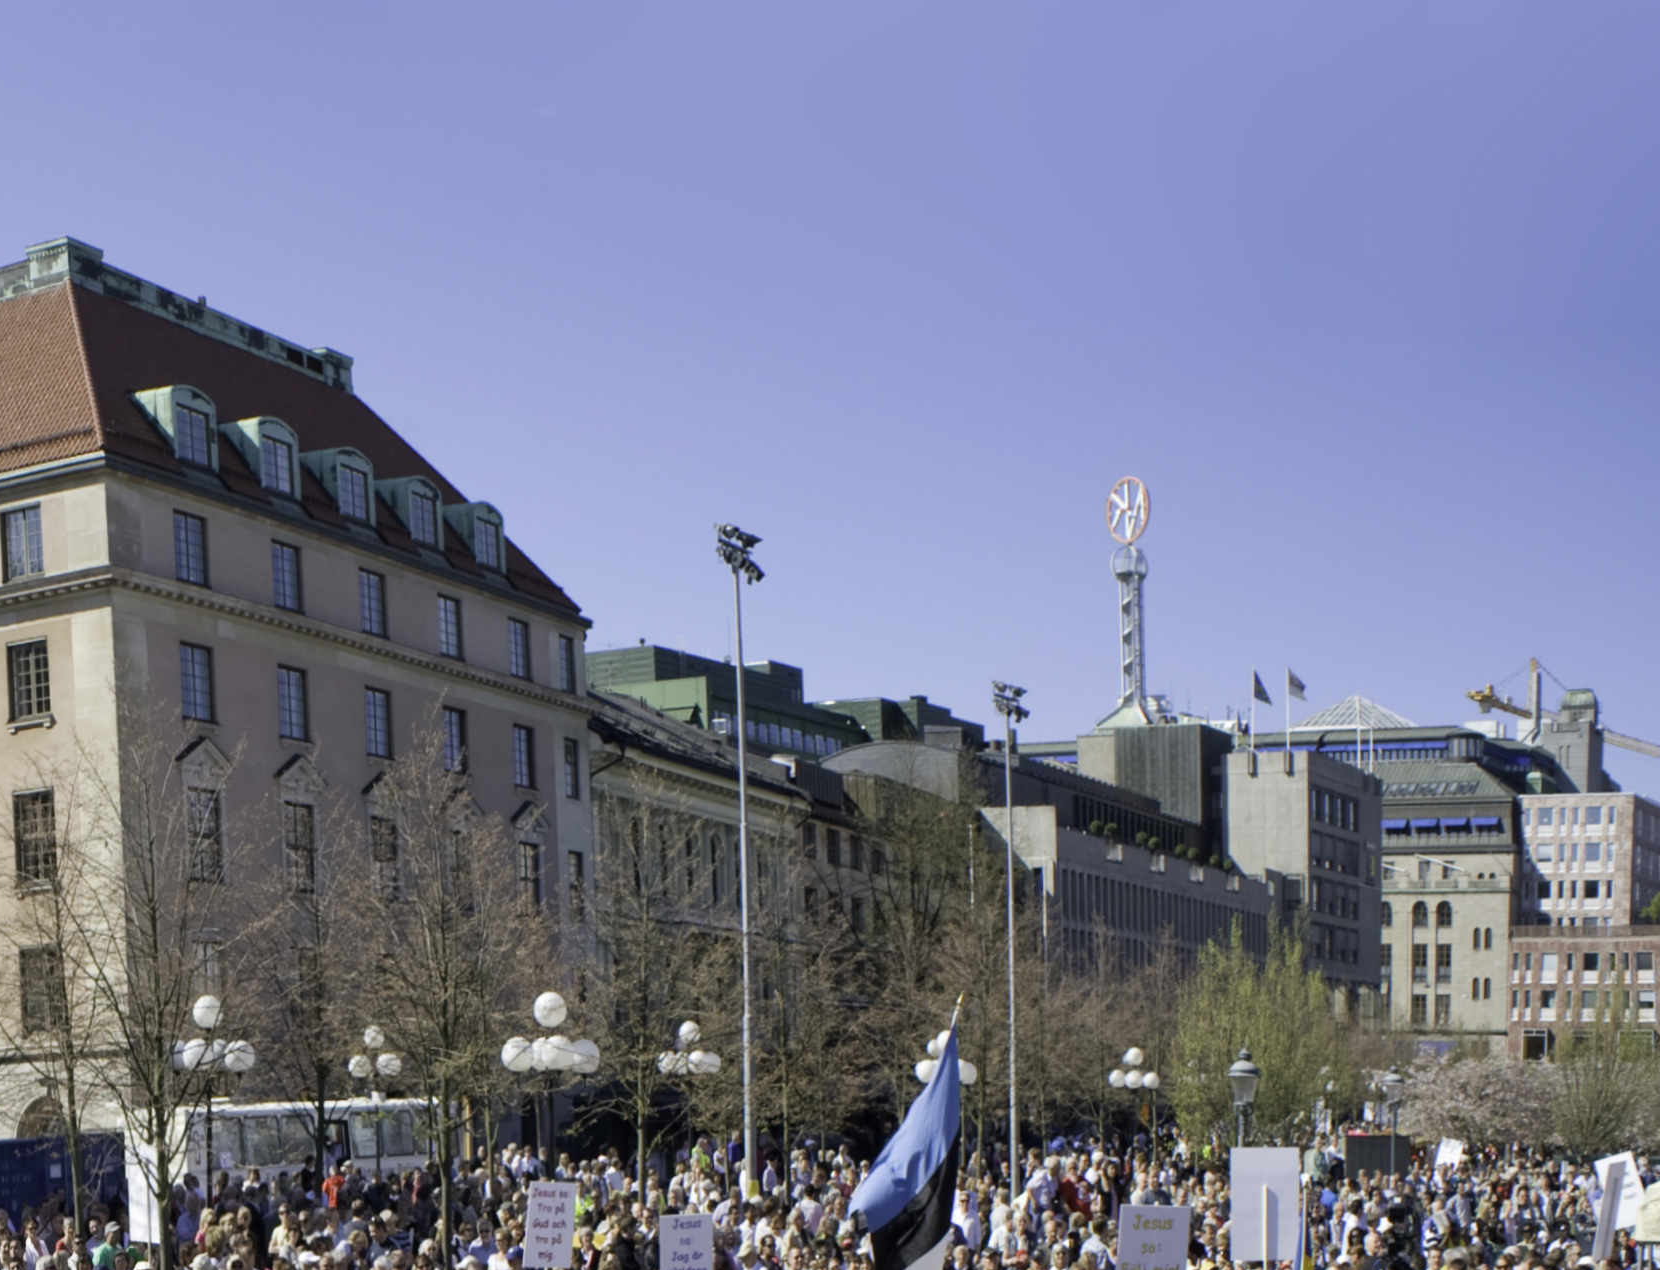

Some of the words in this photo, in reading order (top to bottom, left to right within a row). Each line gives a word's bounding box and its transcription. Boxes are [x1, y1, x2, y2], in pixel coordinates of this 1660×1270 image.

[532, 1188, 556, 1199] Jesus
[537, 1202, 552, 1213] Tro
[554, 1202, 565, 1216] på
[533, 1219, 548, 1229] Gud
[552, 1220, 567, 1229] och
[672, 1219, 702, 1230] Jesus
[1133, 1213, 1173, 1231] Jesus
[551, 1234, 562, 1250] på
[1141, 1242, 1162, 1254] sa:
[671, 1252, 689, 1264] Jag
